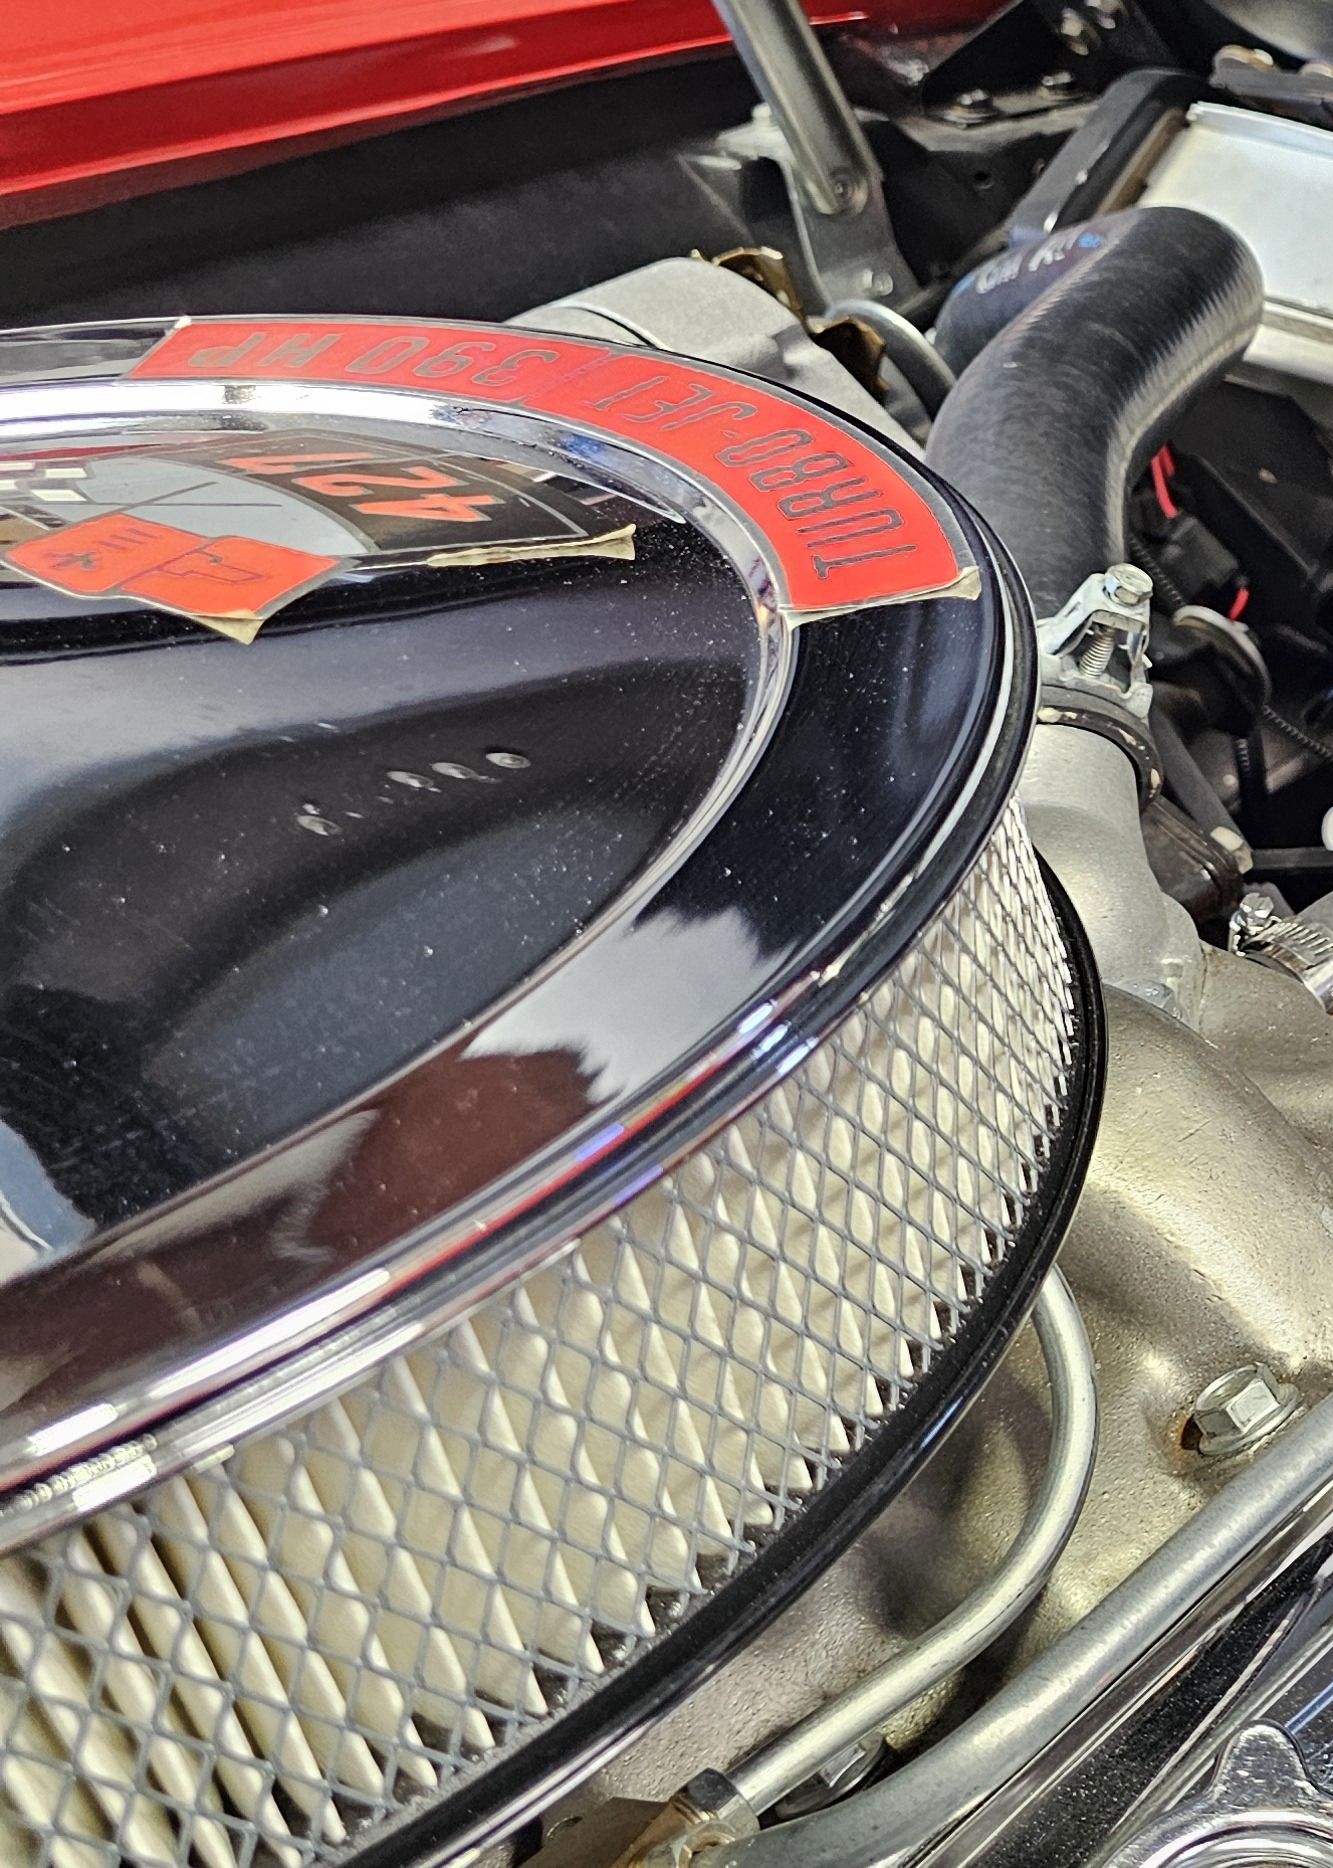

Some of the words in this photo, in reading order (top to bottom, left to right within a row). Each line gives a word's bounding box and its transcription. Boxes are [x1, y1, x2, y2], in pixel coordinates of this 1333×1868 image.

[188, 332, 343, 368] HP
[345, 337, 560, 386] 390
[218, 451, 504, 522] 427
[583, 376, 917, 579] TURBO-JET
